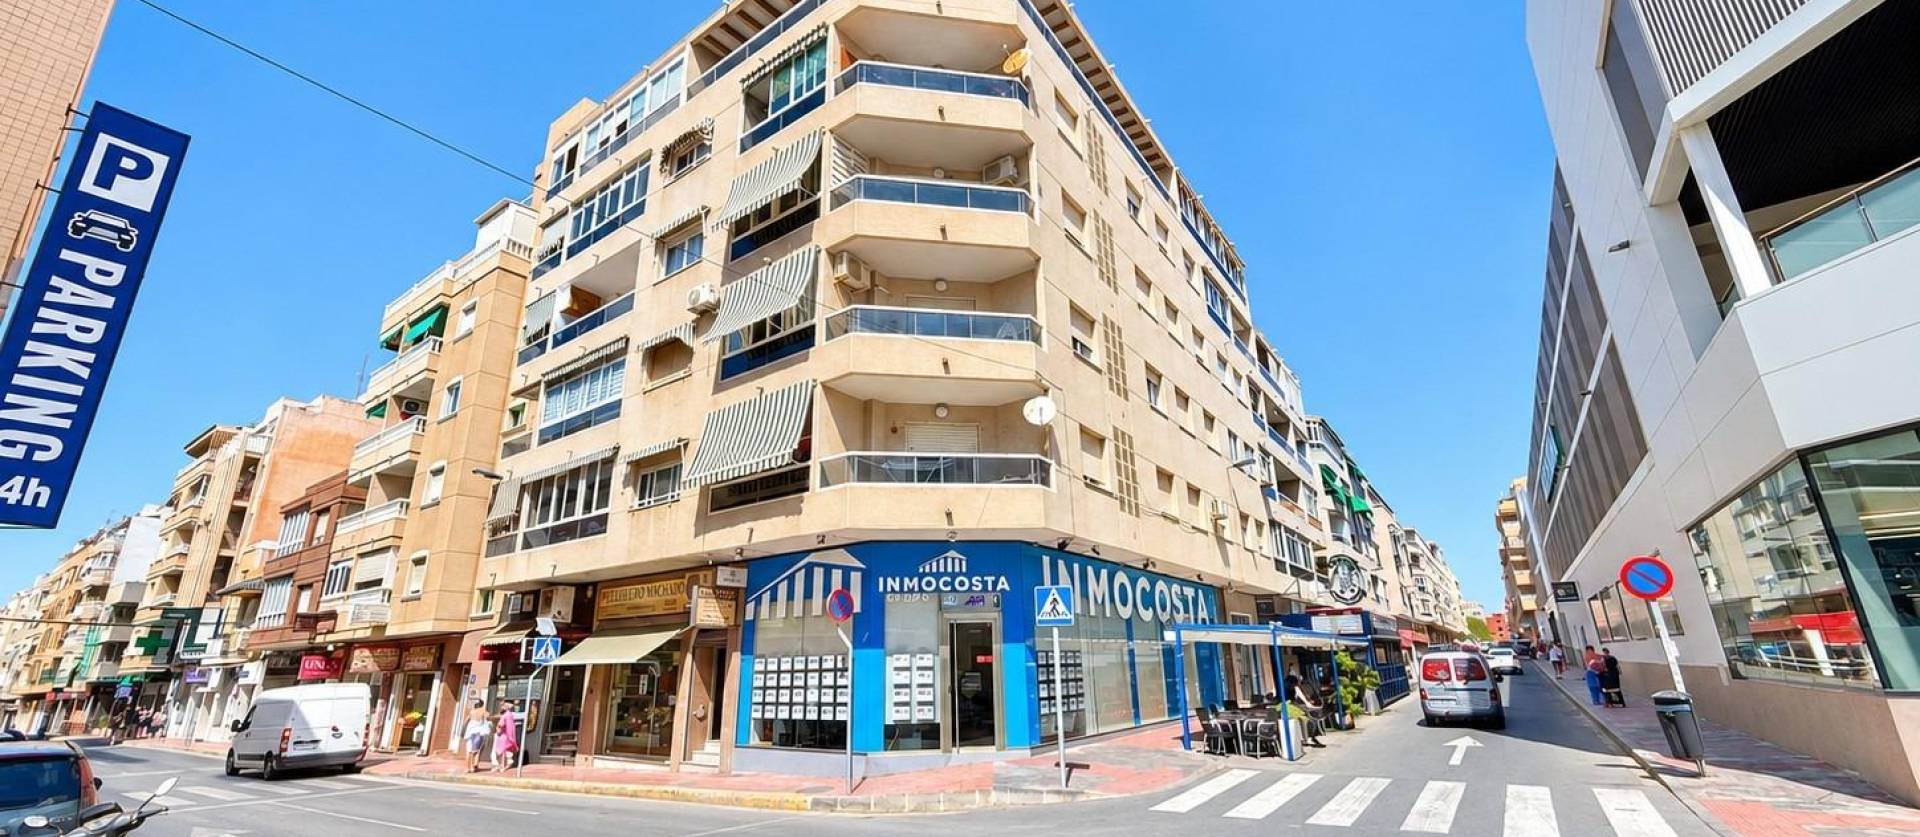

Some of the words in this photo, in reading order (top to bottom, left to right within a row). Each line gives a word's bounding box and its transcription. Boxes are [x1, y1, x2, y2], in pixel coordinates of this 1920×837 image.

[92, 142, 155, 191] P
[0, 248, 127, 462] PARKING
[878, 576, 1010, 592] INMOCOSTA
[1042, 555, 1210, 625] INMOCOSTA
